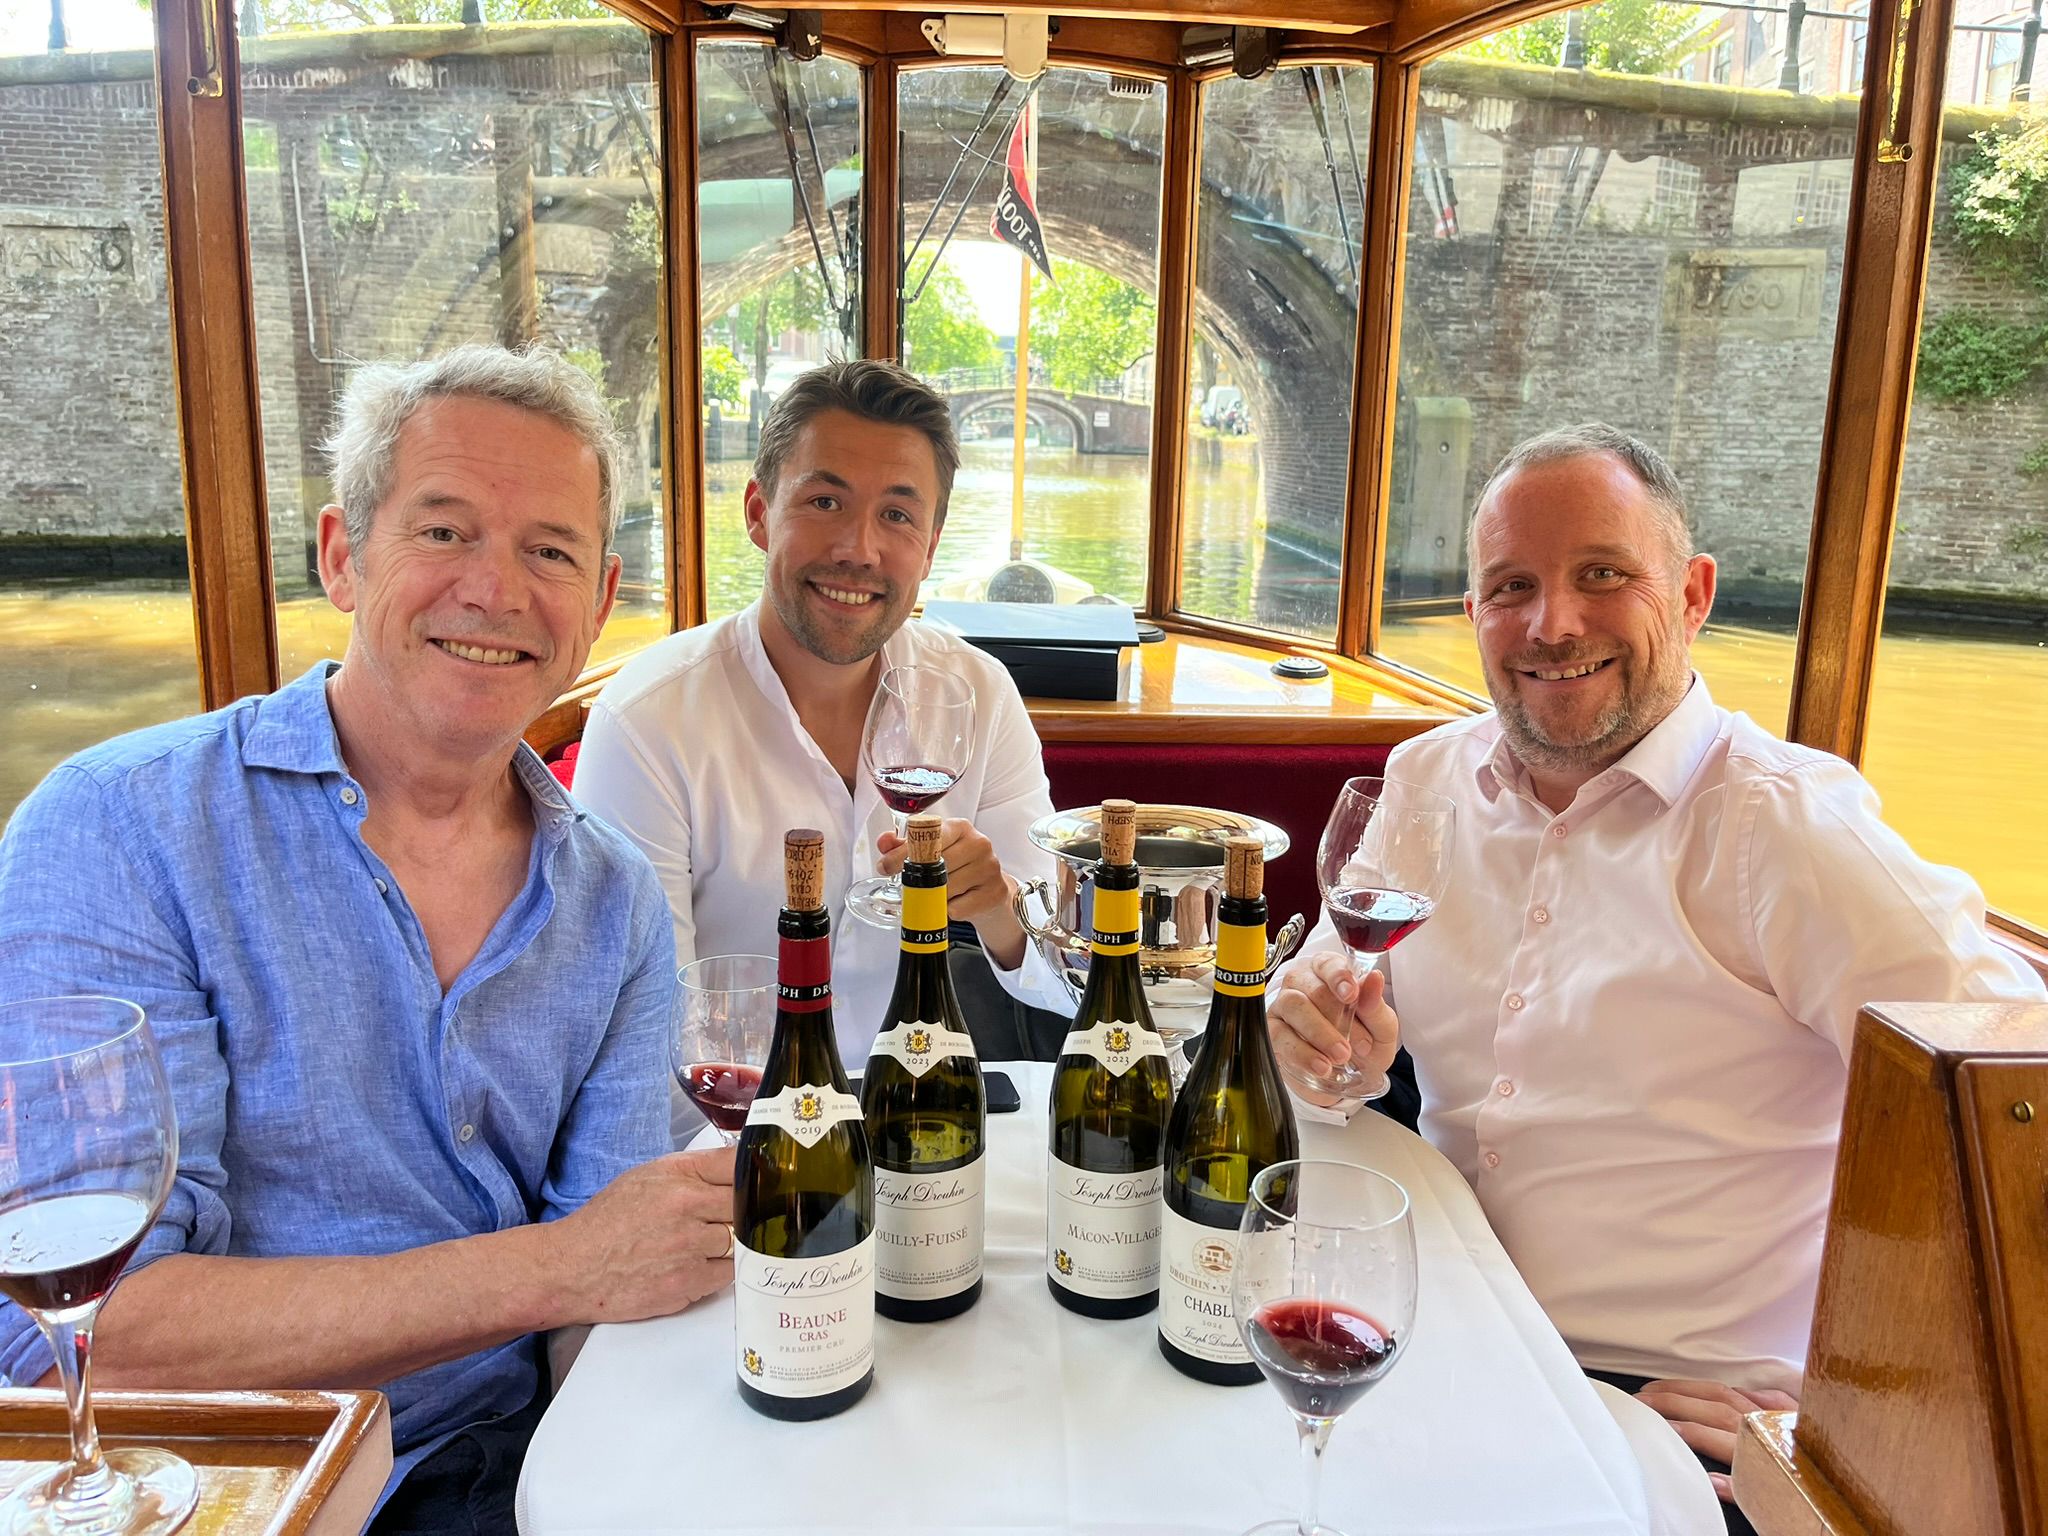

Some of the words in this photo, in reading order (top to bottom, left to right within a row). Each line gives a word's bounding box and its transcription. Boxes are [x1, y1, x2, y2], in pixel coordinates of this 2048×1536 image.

[906, 1058, 929, 1069] 2023
[1106, 1056, 1129, 1066] 2023
[794, 1127, 821, 1137] 2019
[875, 1178, 911, 1205] Joseph
[912, 1180, 965, 1202] Drouhin
[1071, 1177, 1114, 1204] Joseph
[875, 1226, 968, 1247] OUILLY-FUISSÉ
[759, 1266, 808, 1296] Joseph
[809, 1259, 863, 1288] Drouhin
[1169, 1264, 1210, 1290] DROUHIN
[779, 1308, 847, 1330] BEAUNE
[779, 1344, 821, 1353] PREMIER
[826, 1339, 845, 1349] CRU
[799, 1330, 829, 1342] CRAS
